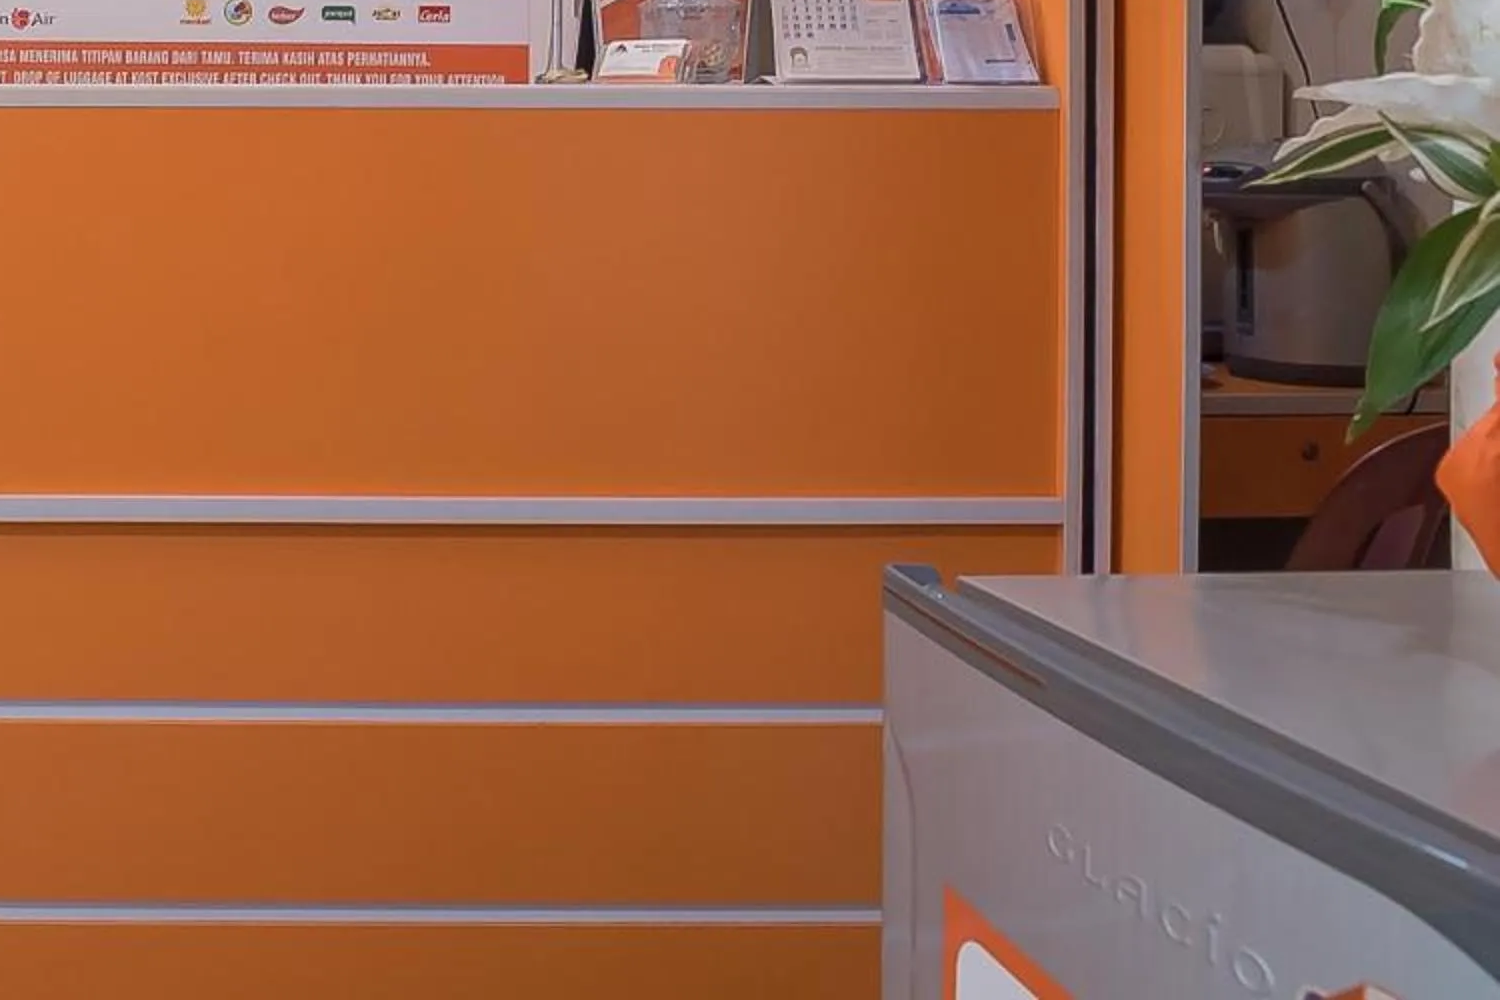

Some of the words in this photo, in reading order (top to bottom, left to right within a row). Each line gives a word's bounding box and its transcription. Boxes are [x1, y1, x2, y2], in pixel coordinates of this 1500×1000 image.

[30, 10, 56, 26] Air
[19, 49, 78, 64] MENERIMA
[81, 50, 123, 64] TITIPAN
[125, 50, 169, 64] BARANG
[238, 51, 278, 65] TERIMA
[283, 51, 315, 66] KASIH
[318, 51, 345, 66] ATAS
